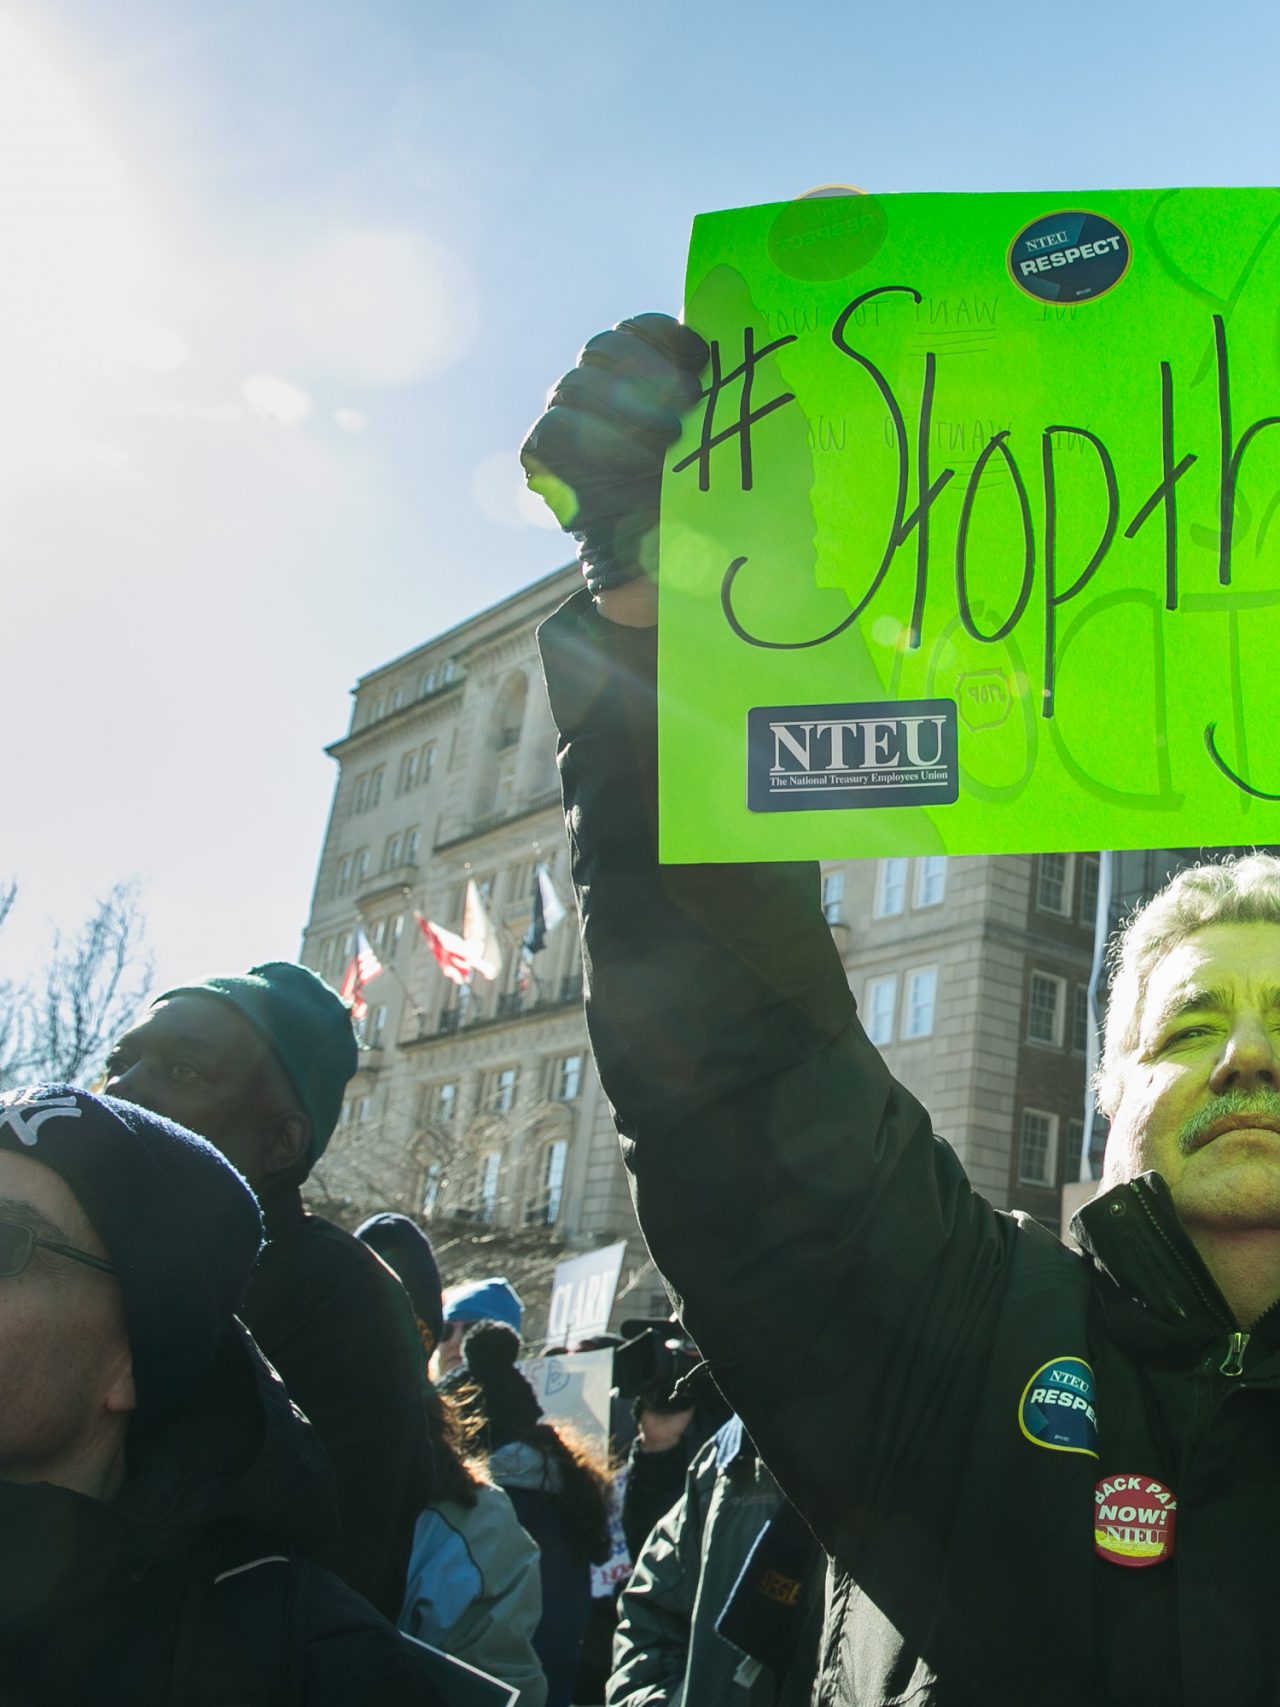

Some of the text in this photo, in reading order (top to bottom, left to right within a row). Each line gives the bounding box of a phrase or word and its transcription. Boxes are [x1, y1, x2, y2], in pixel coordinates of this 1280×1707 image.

[1025, 231, 1069, 252] NTEU
[1020, 236, 1120, 276] RESPECT
[769, 719, 947, 771] NTEU
[770, 770, 948, 787] The National Treasury Employees Union
[1049, 1370, 1090, 1393] NTEU
[1030, 1388, 1098, 1430] RESPE
[1095, 1477, 1177, 1510] BACK PAY
[1098, 1505, 1167, 1525] NOW!
[1107, 1526, 1161, 1545] NTEU
